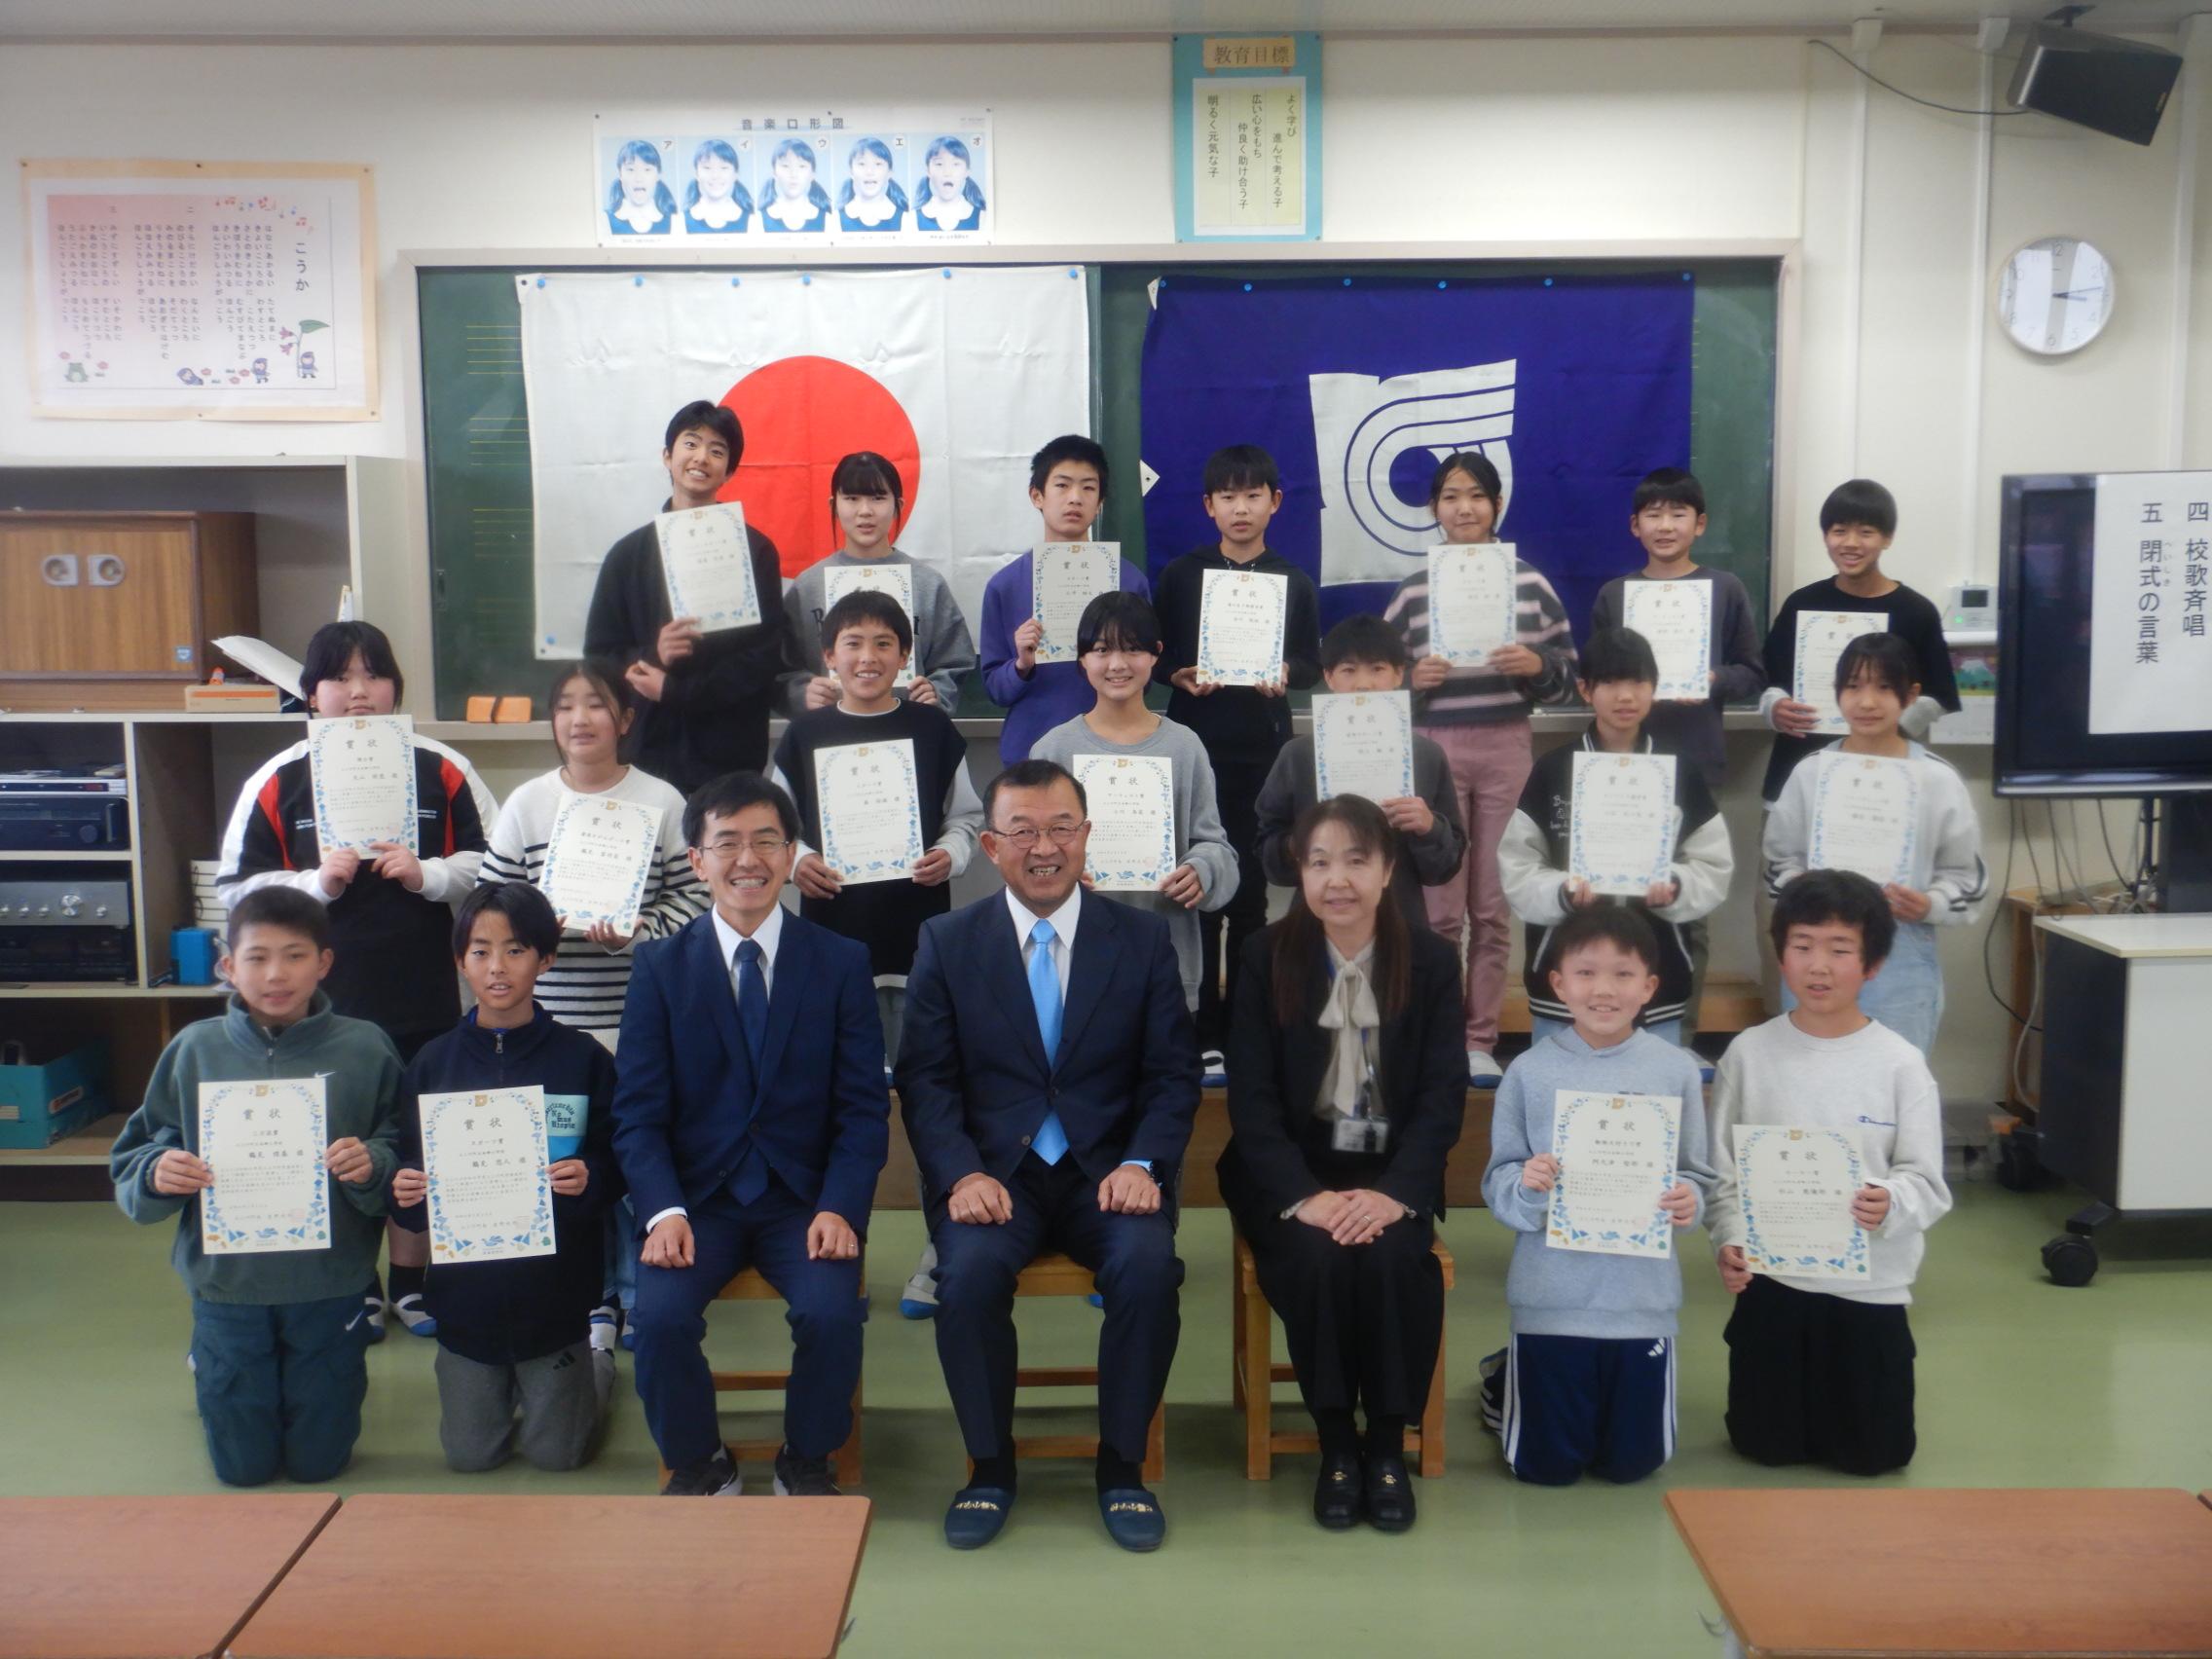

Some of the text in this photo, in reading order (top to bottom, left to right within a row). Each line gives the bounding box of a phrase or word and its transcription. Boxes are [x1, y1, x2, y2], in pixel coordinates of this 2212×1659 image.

[1214, 44, 1290, 65] 教育目標
[741, 117, 844, 130] 音楽口形図
[1207, 94, 1219, 178] 明るく元気な子
[1251, 93, 1263, 159] 広い心をもち
[1285, 93, 1298, 137] よく学び
[1237, 122, 1249, 209] 仲良く助け合う子
[1271, 132, 1283, 208] 進んで考える子
[295, 241, 310, 292] こうか
[2136, 502, 2162, 664] 五 閉式の言葉
[2183, 501, 2209, 638] 四 校歌斉唱
[1108, 777, 1138, 786] 賞状
[242, 1107, 281, 1122] 賞状
[463, 1117, 503, 1131] 賞状
[1597, 1119, 1637, 1131] 賞状
[1779, 1150, 1819, 1161] 賞状
